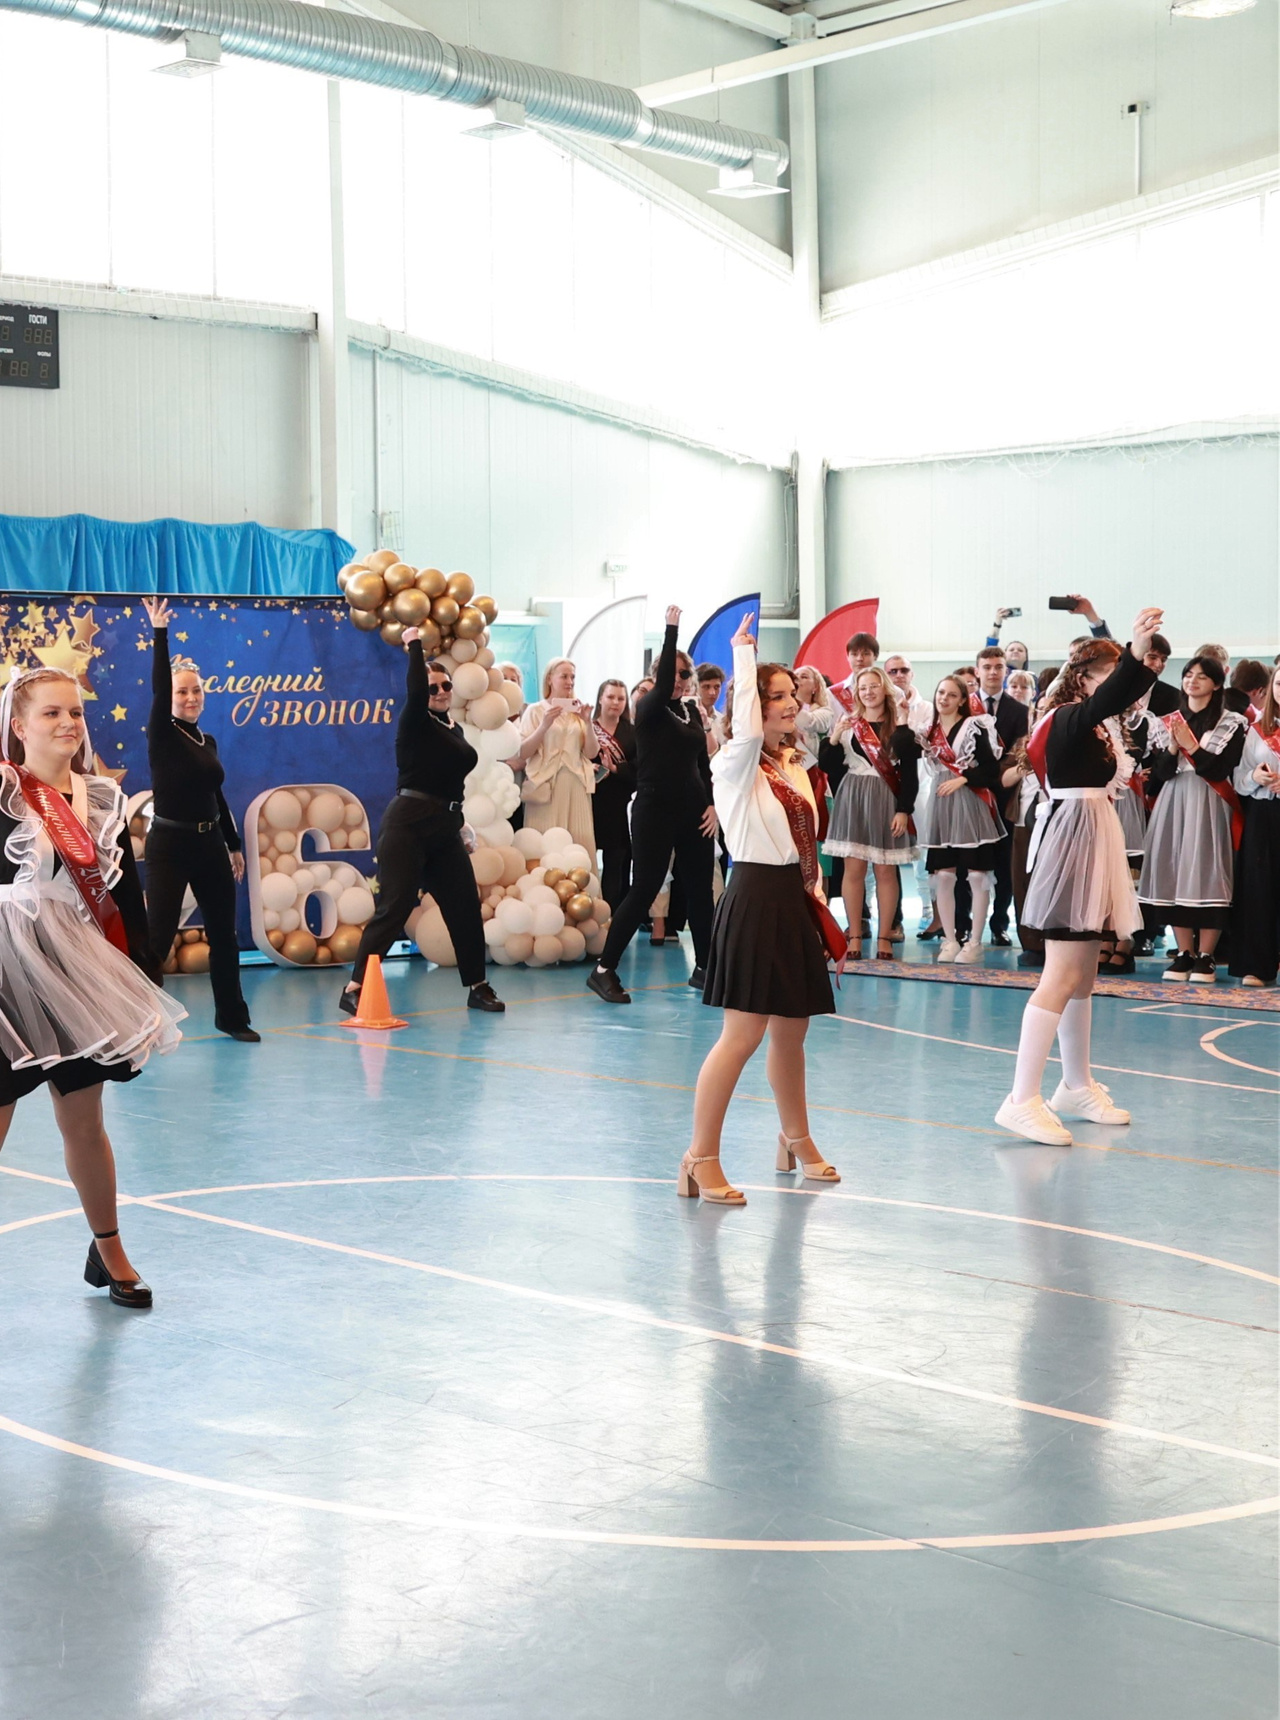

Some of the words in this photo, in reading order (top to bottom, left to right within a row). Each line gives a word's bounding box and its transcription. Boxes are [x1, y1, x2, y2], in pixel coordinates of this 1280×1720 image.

[28, 314, 48, 325] ГОСТИ
[170, 654, 325, 727] следний
[260, 698, 395, 727] ЗВОНОК
[786, 789, 812, 875] Выпускница
